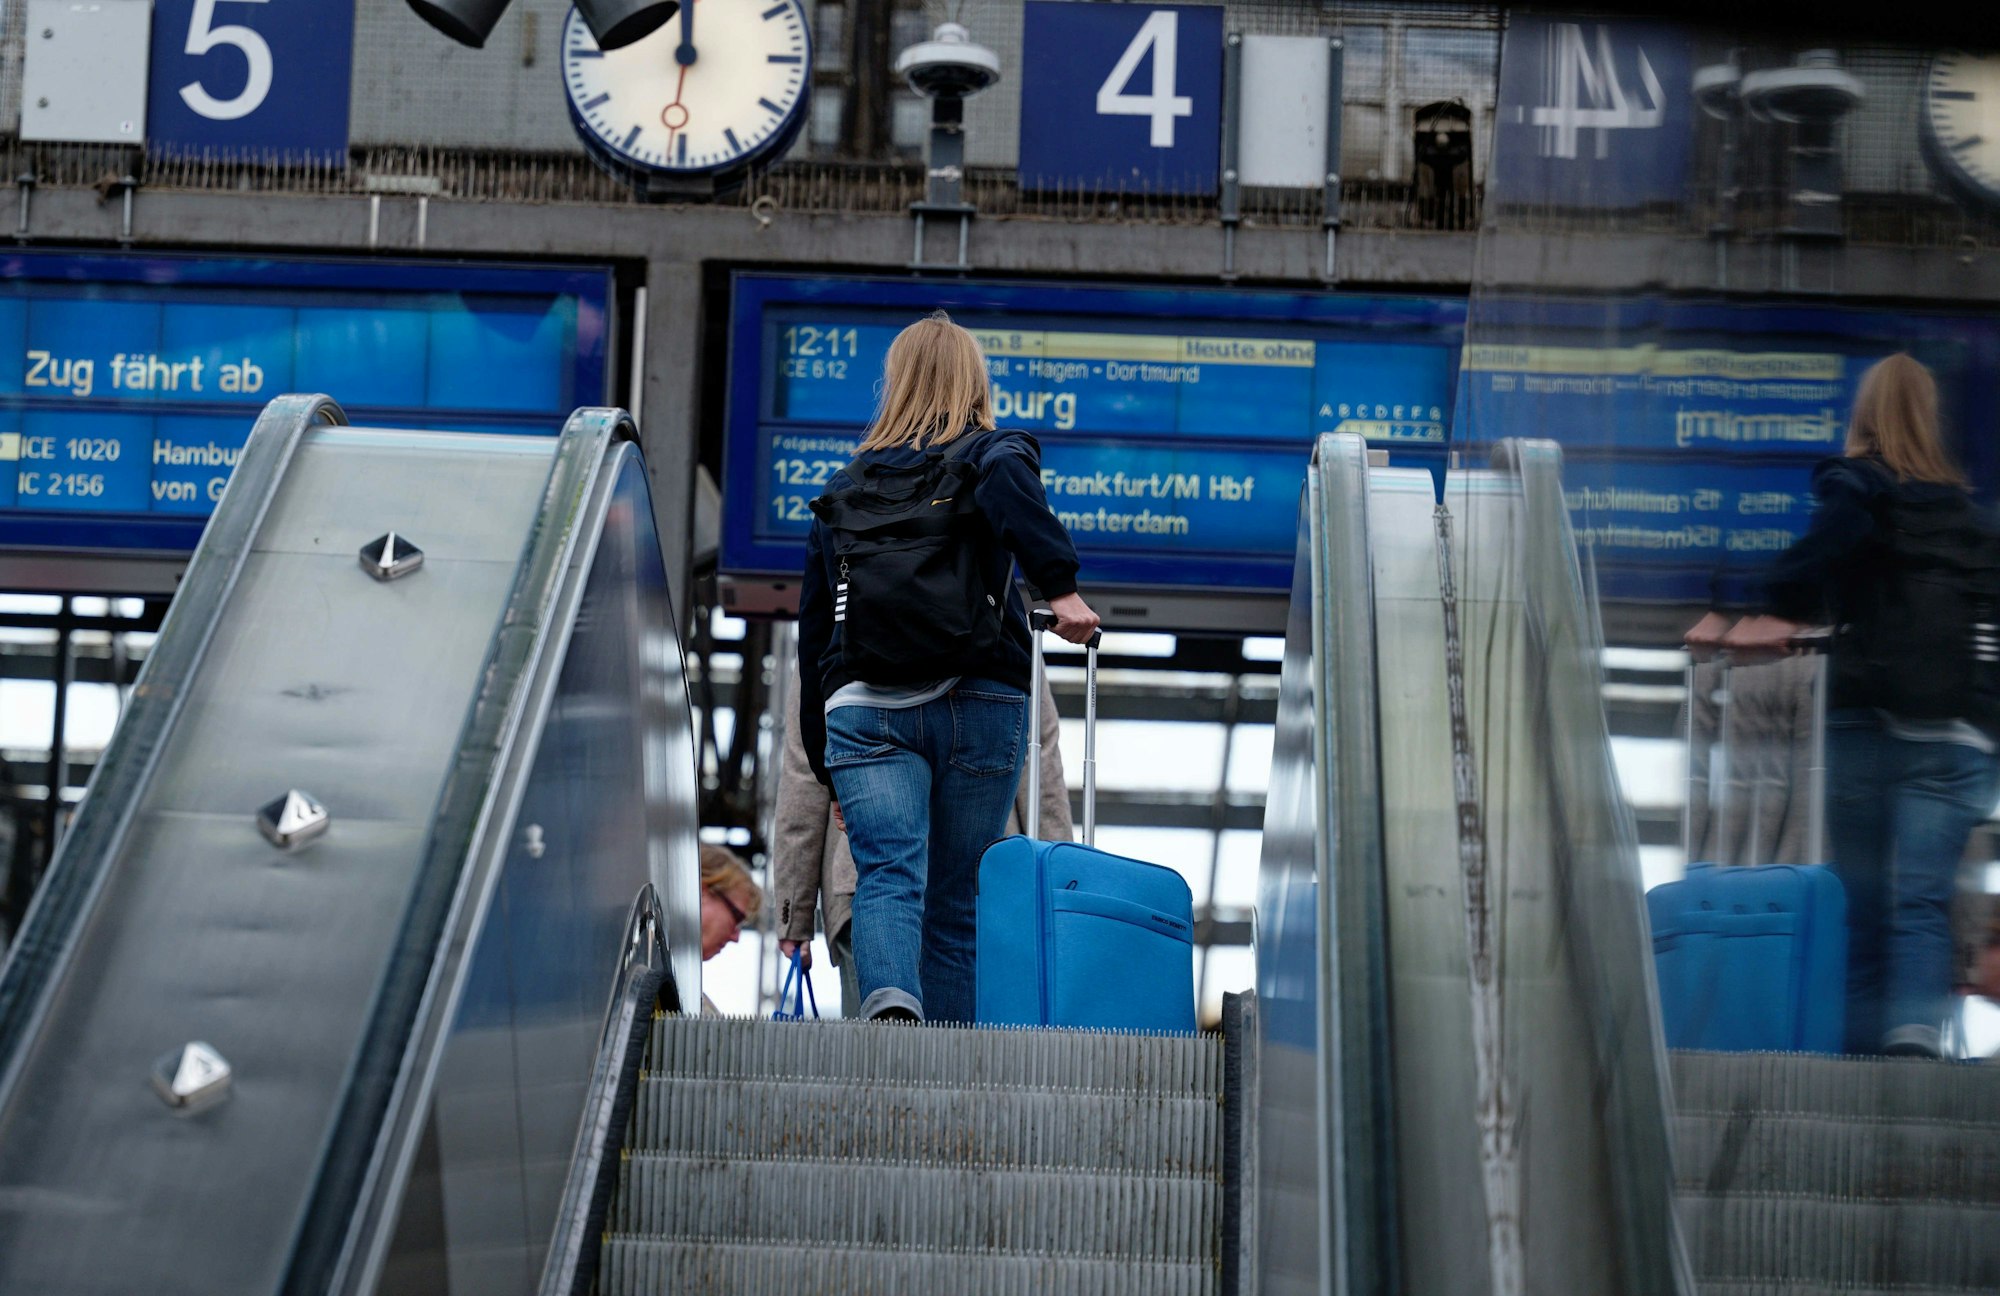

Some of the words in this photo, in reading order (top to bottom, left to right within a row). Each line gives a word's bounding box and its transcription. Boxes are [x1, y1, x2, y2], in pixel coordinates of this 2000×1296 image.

[178, 0, 273, 120] 5
[1096, 10, 1192, 148] 4
[784, 326, 857, 358] 12:11
[1186, 341, 1256, 359] Heute
[25, 350, 94, 396] Zug
[110, 353, 204, 391] fährt
[219, 358, 264, 393] ab
[812, 360, 848, 380] 612
[1029, 359, 1089, 383] Hagen
[1106, 361, 1200, 384] Dortmund
[21, 436, 56, 459] ICE
[66, 438, 120, 461] 1020
[18, 472, 40, 495] IC
[47, 473, 104, 496] 2156
[151, 480, 197, 501] von
[1209, 475, 1255, 501] Hbf
